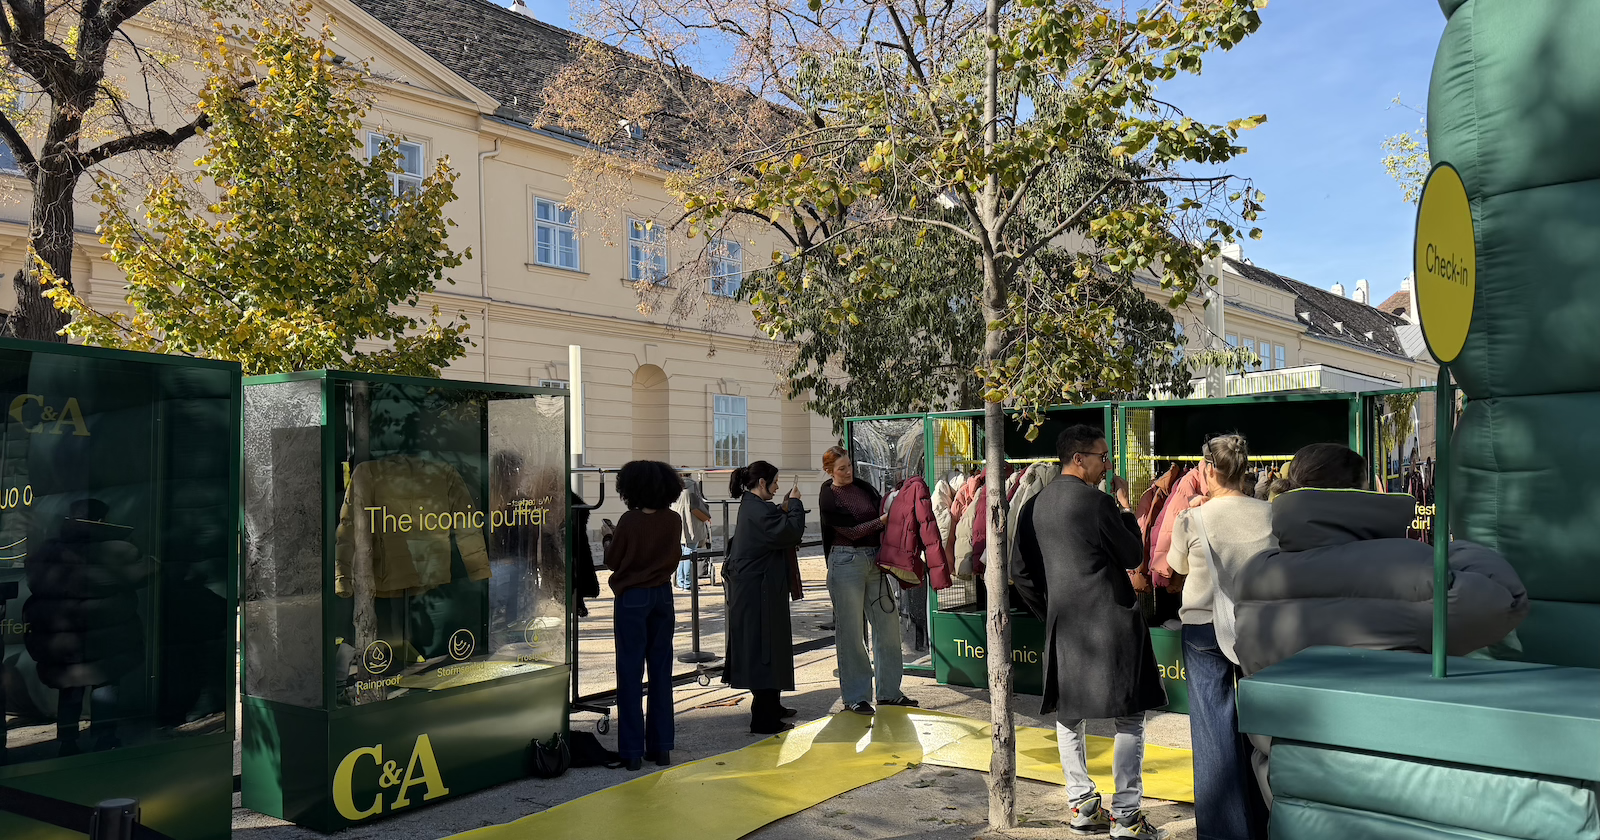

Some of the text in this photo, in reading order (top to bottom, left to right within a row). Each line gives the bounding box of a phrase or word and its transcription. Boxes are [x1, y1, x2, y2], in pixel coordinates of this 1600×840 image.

[1425, 243, 1468, 287] Check-in
[9, 393, 91, 436] C&A
[364, 502, 549, 533] The iconic puffer
[1411, 516, 1431, 530] dir!
[0, 619, 32, 635] ffer.
[953, 639, 984, 659] The
[1009, 645, 1037, 664] nic
[356, 674, 402, 693] Rainproof
[332, 733, 449, 820] C&A
